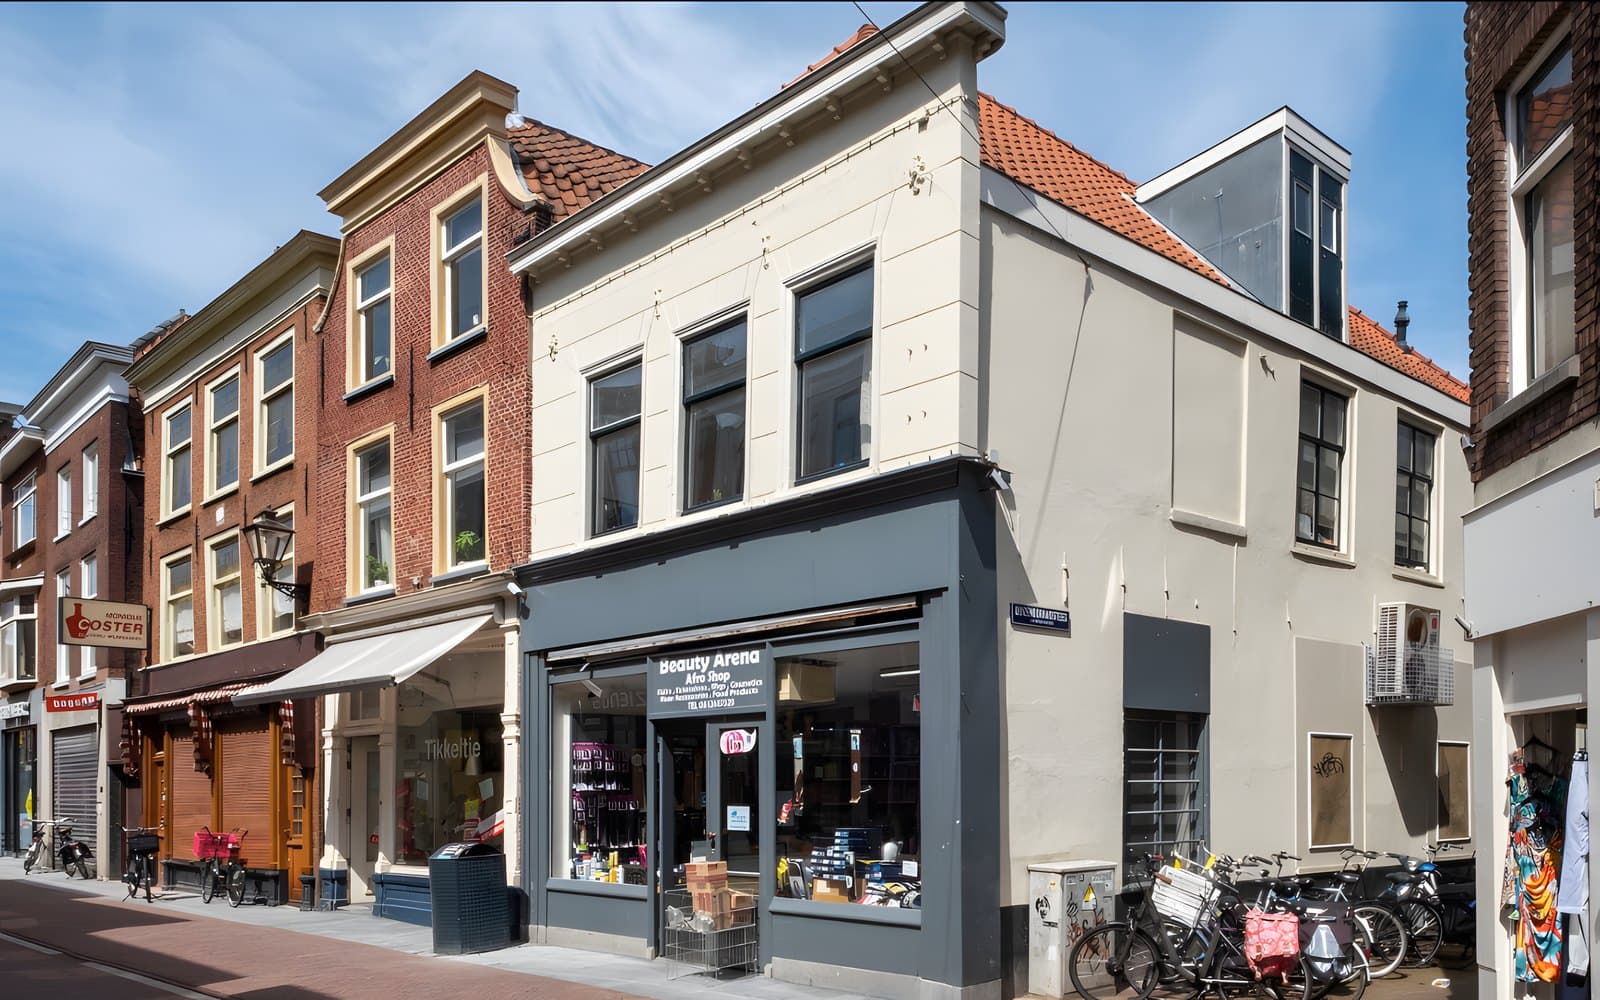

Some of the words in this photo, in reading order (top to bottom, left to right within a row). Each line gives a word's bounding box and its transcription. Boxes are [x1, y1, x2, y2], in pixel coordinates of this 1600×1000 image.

[78, 619, 143, 635] COSTER
[660, 656, 710, 674] Beauty
[713, 650, 760, 668] Arena
[685, 672, 706, 685] Afro
[708, 671, 731, 683] Shop
[424, 736, 481, 760] Tikkeltje
